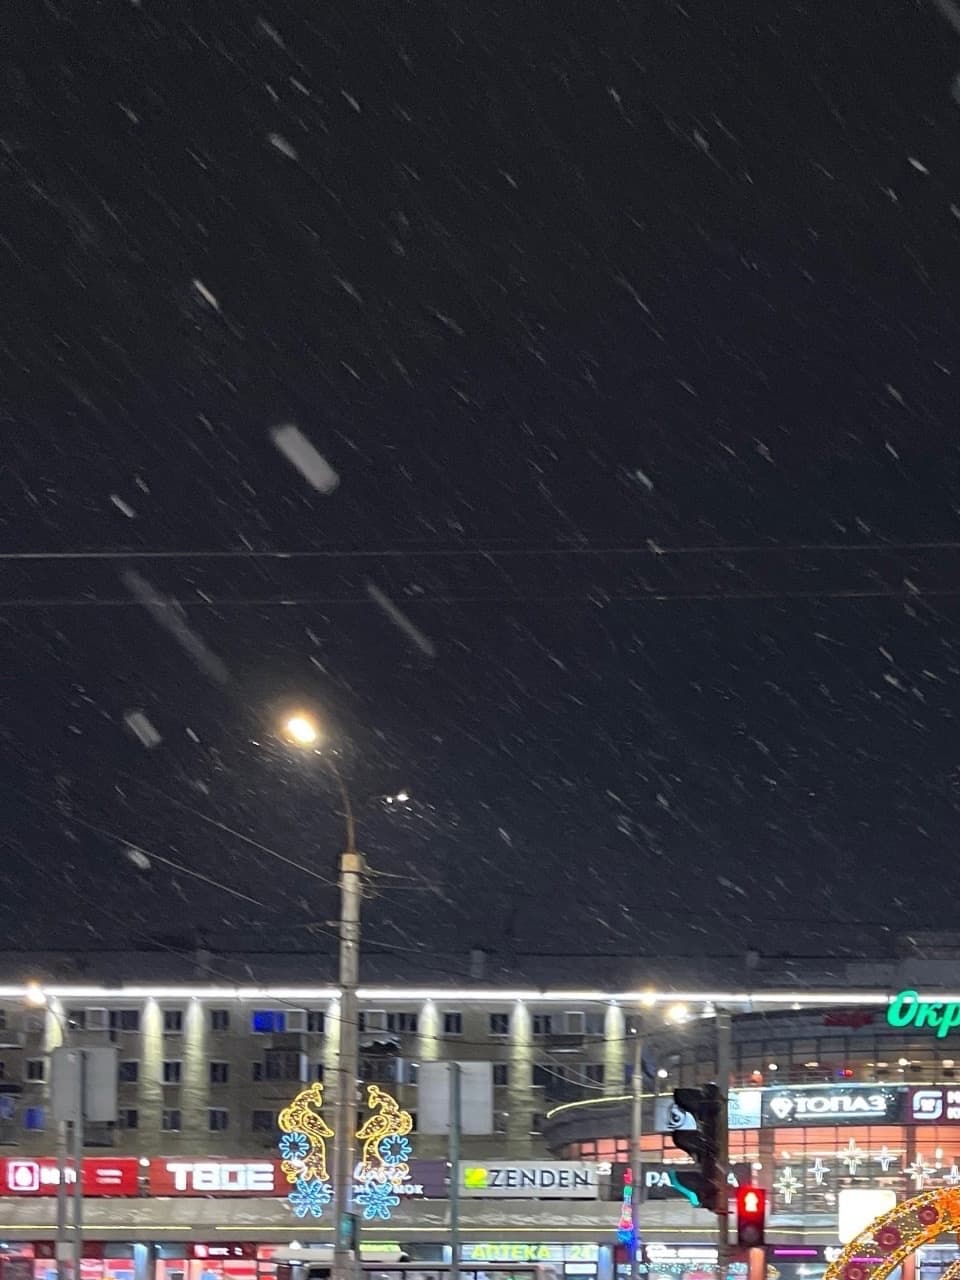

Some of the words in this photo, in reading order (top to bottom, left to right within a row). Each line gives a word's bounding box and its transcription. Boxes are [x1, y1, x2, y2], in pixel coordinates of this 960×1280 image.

[794, 1095, 887, 1113] ТОПАЗ
[166, 1163, 275, 1191] ТВОЕ
[490, 1169, 593, 1188] ZENDEN
